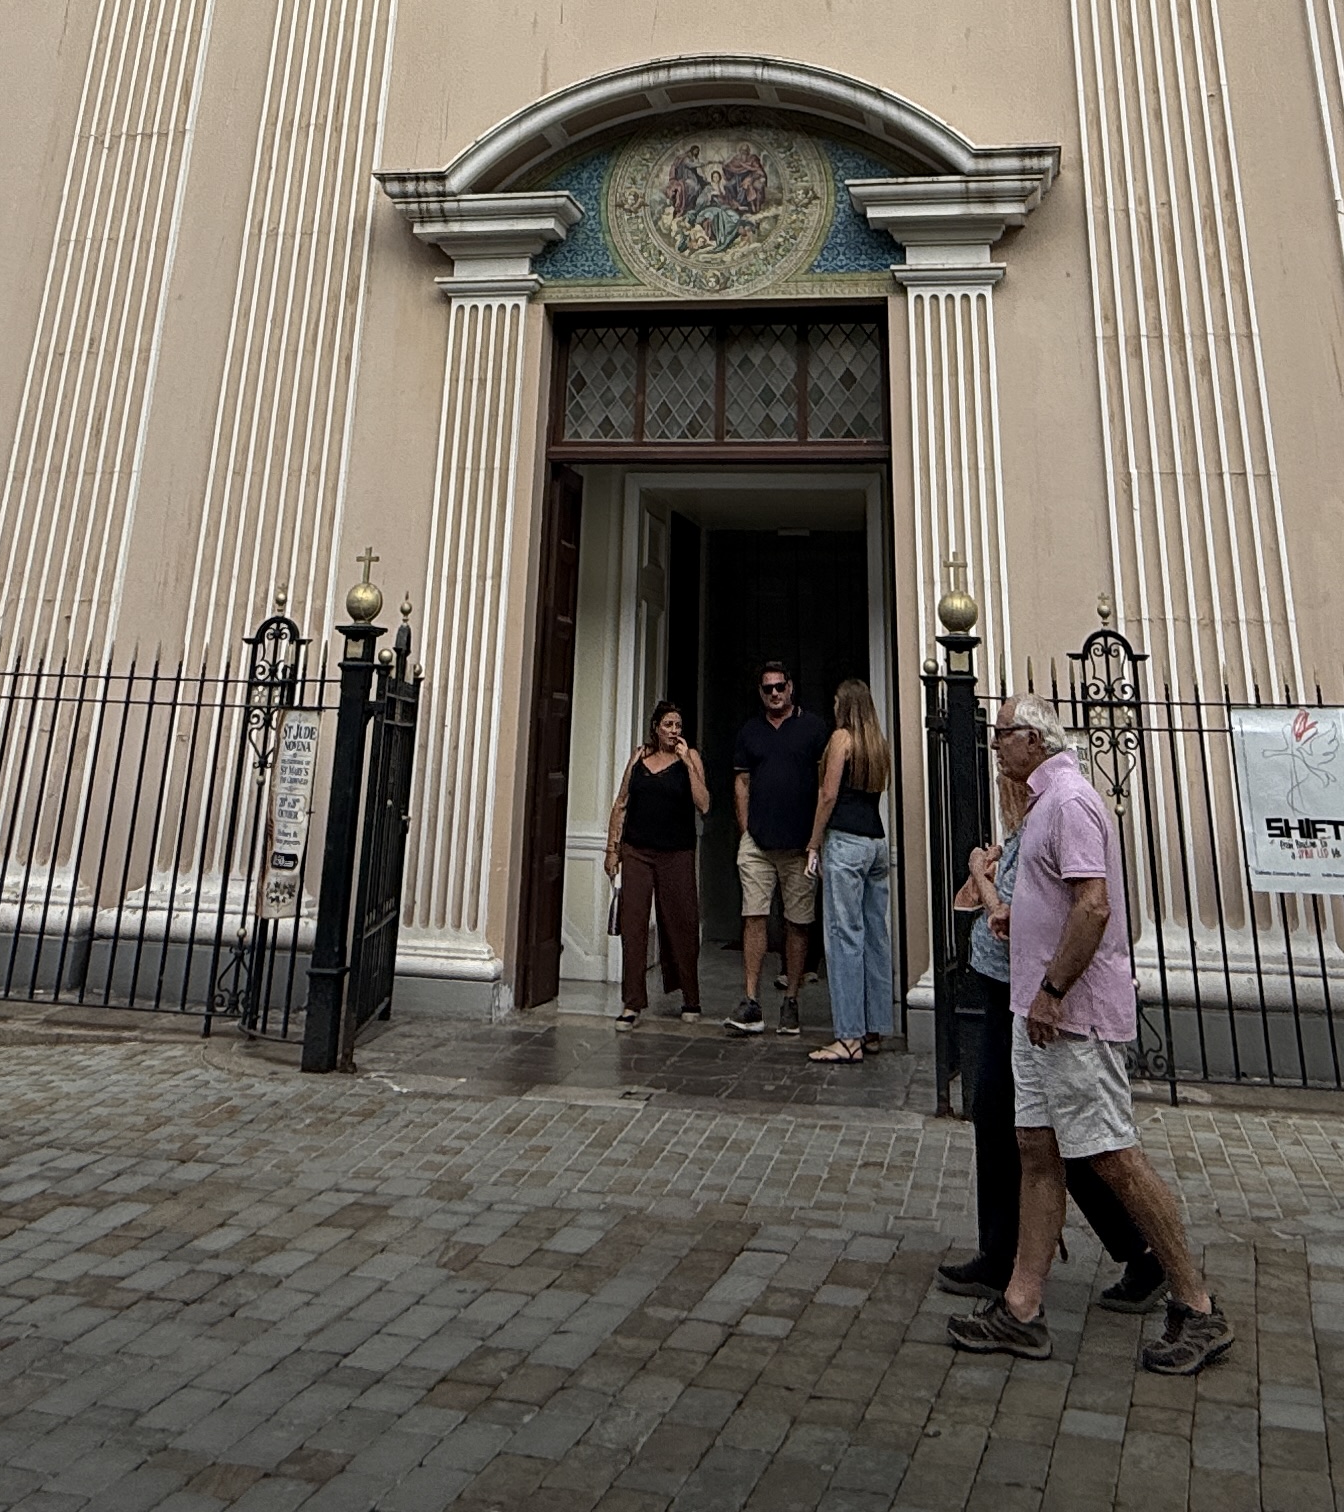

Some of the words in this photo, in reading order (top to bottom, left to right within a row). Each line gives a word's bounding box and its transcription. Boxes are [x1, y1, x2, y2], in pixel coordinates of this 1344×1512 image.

[293, 723, 318, 741] JUDE
[284, 740, 312, 753] NOVENA
[1265, 818, 1344, 841] SHIFT
